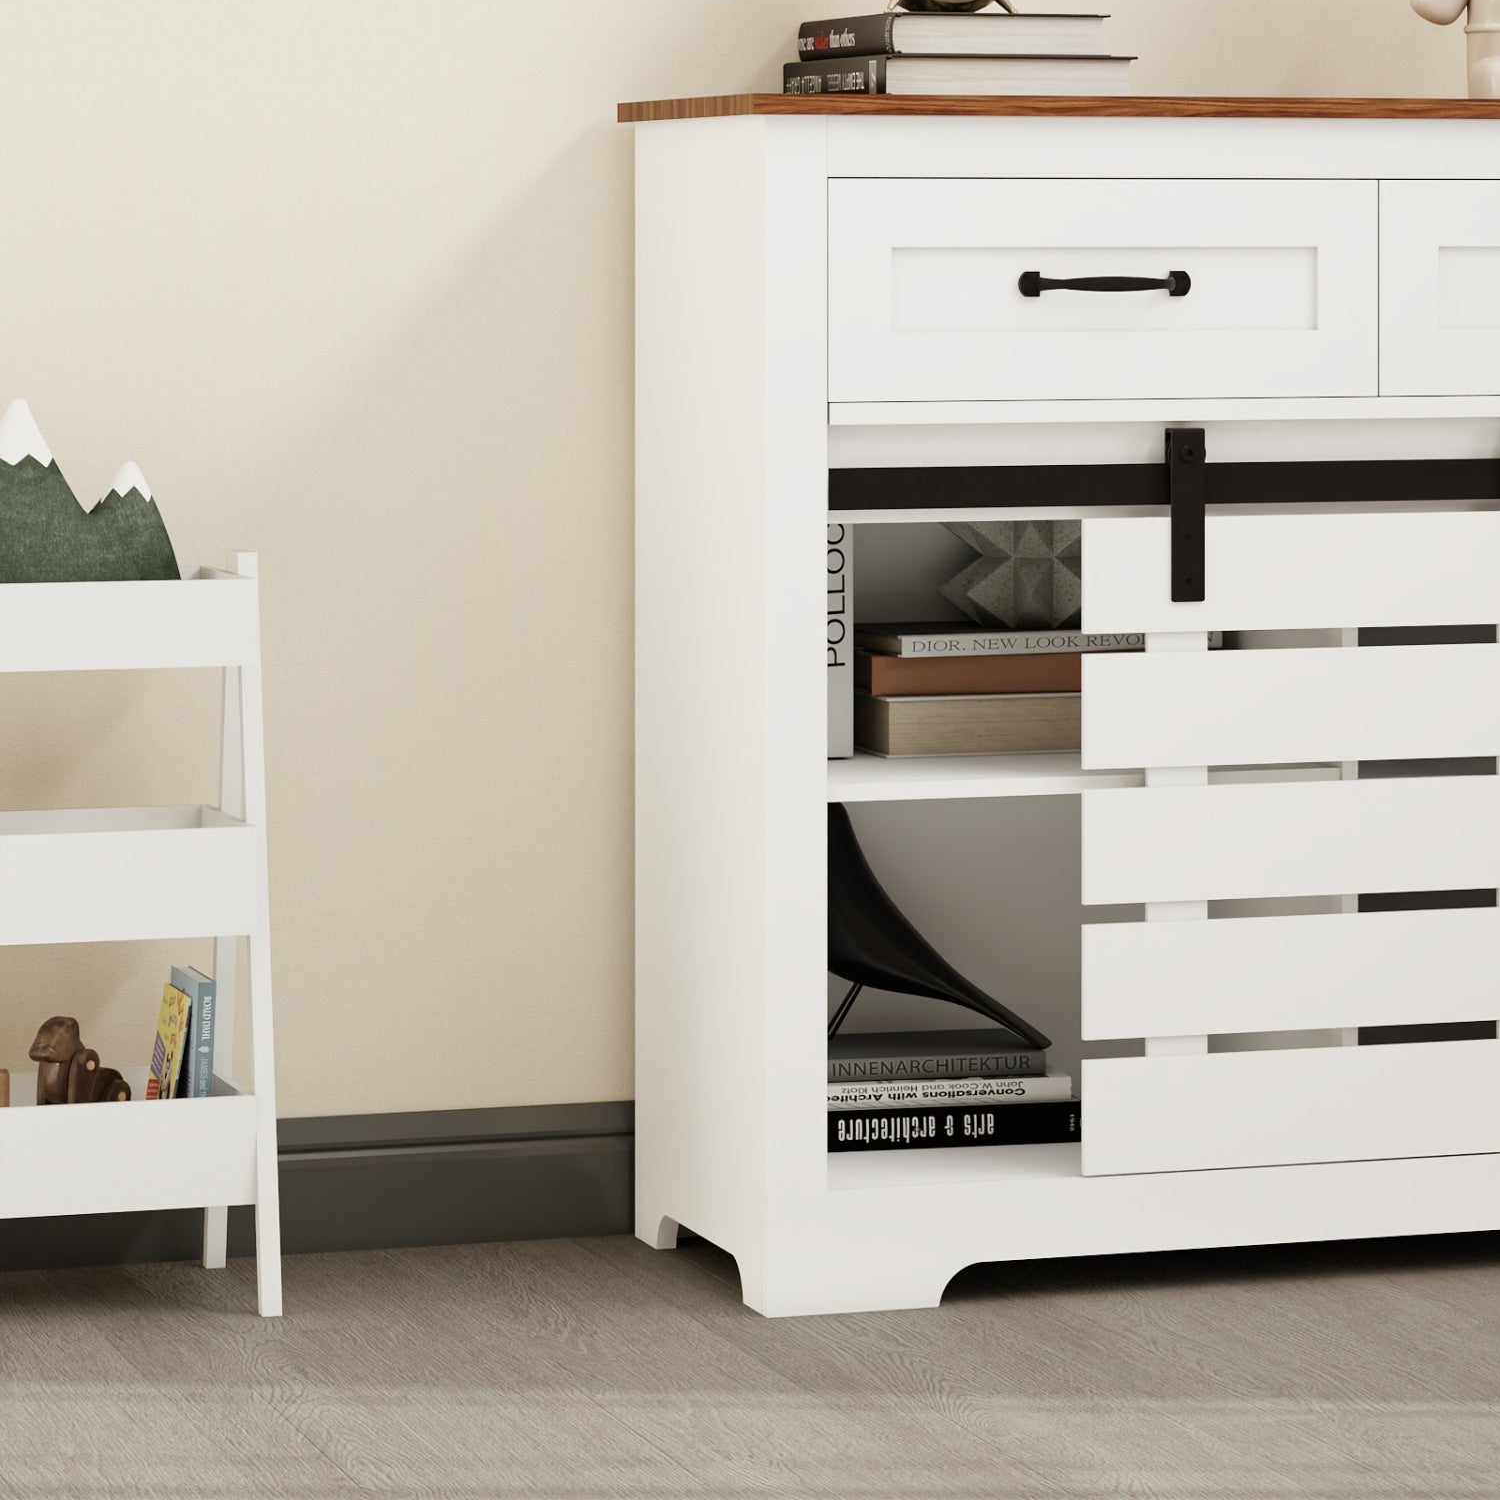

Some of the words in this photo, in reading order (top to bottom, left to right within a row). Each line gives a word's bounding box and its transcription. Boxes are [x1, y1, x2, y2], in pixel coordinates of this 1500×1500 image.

[912, 638, 966, 653] DIOR.
[973, 637, 1019, 651] NEW
[1024, 635, 1084, 650] LOOK
[832, 1055, 1030, 1077] INNENARCHITEKTUR
[872, 1085, 918, 1093] Heinrich
[996, 1081, 1024, 1089] John
[891, 1090, 917, 1100] with
[922, 1088, 1026, 1099] Conversations
[837, 1115, 936, 1144] architecture
[963, 1113, 995, 1139] arts
